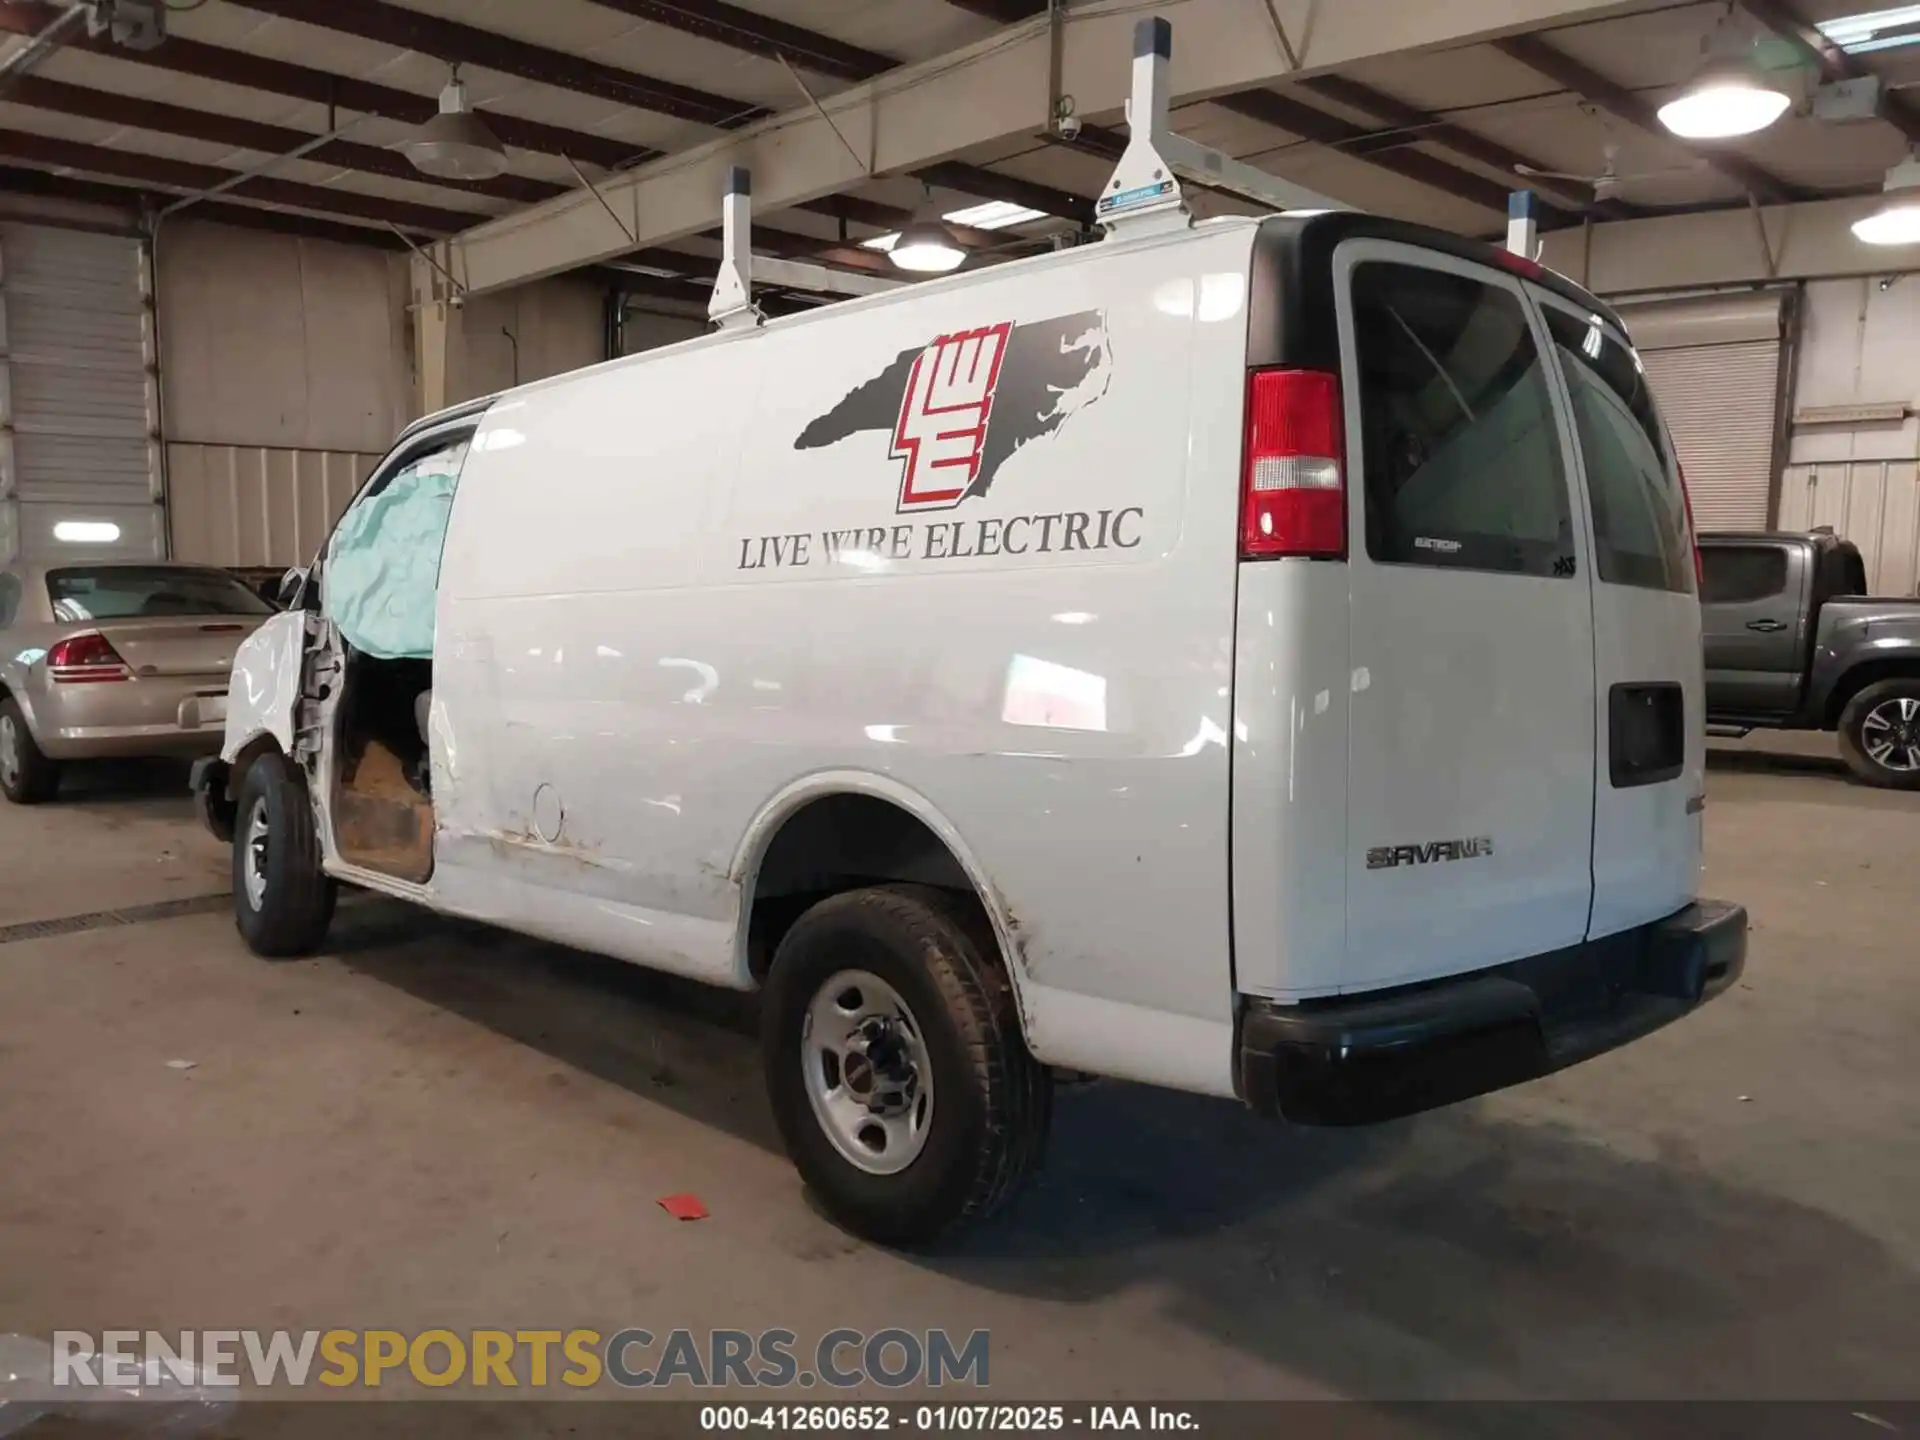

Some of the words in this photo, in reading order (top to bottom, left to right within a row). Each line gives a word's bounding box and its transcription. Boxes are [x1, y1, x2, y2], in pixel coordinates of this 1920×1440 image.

[738, 533, 812, 570] LIVE
[821, 524, 914, 566] WIRE
[920, 507, 1144, 560] ELECTRIC
[1366, 837, 1494, 869] SAVANA
